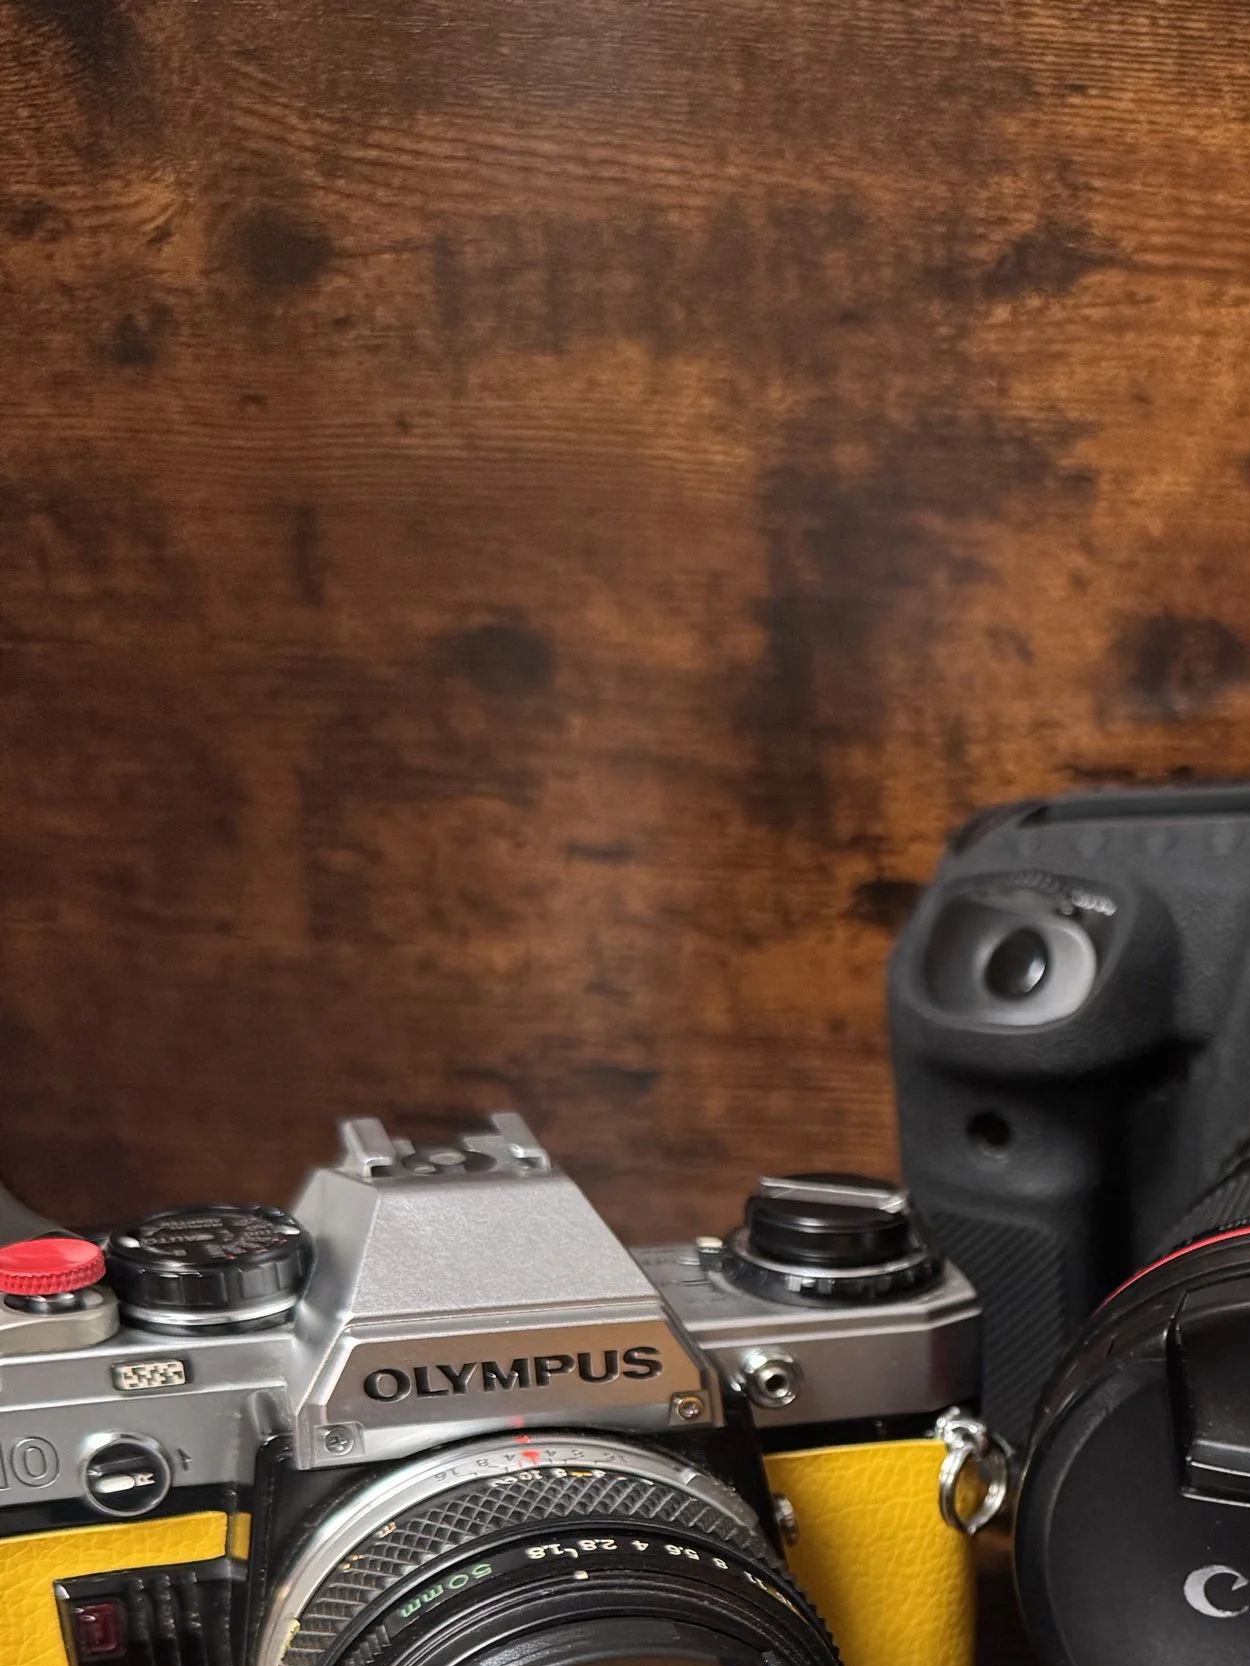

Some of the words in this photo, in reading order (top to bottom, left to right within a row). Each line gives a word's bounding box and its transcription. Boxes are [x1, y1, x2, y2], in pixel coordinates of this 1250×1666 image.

[363, 1346, 664, 1401] OLYMPUS
[578, 1539, 617, 1551] 2.8
[631, 1540, 649, 1551] 4
[664, 1543, 700, 1561] 5.6
[400, 1563, 493, 1618] 50mm
